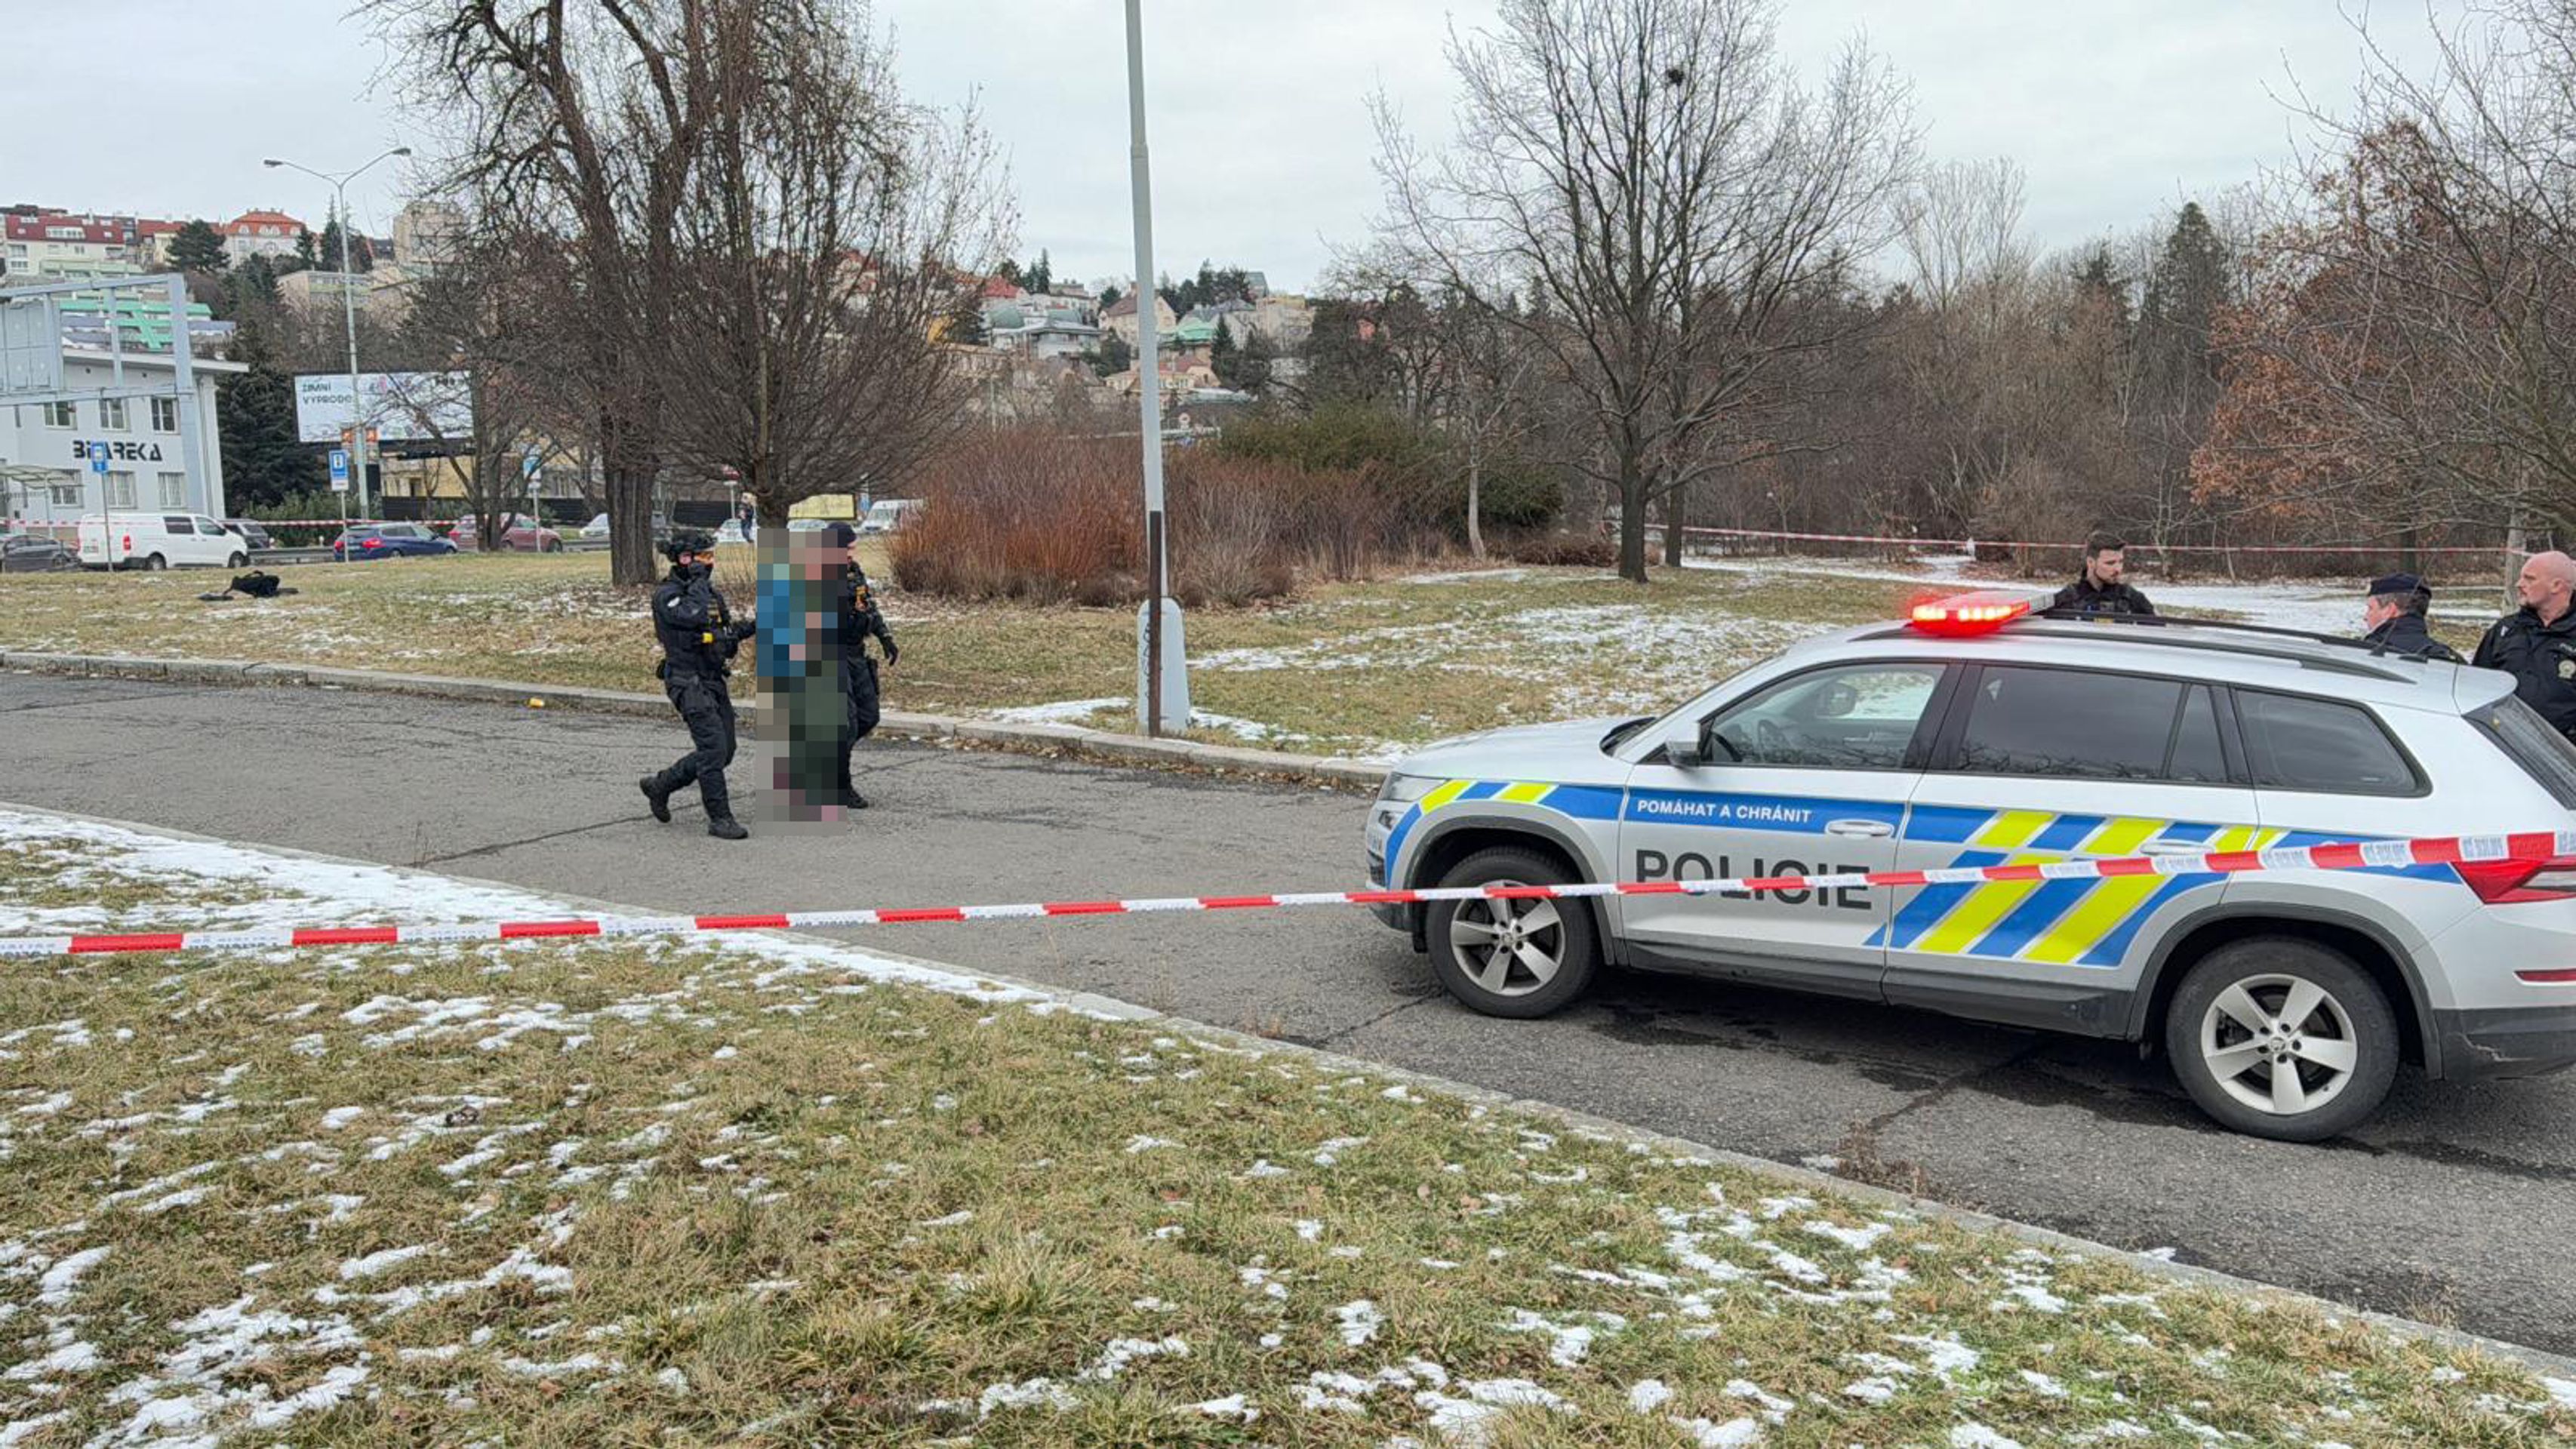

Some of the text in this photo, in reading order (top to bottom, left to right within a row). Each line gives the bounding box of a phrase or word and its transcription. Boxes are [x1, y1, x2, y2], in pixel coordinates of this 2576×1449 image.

[1637, 799, 1812, 823] POMÁHAT A CHRÁNIT
[1636, 849, 1872, 910] POLICIE
